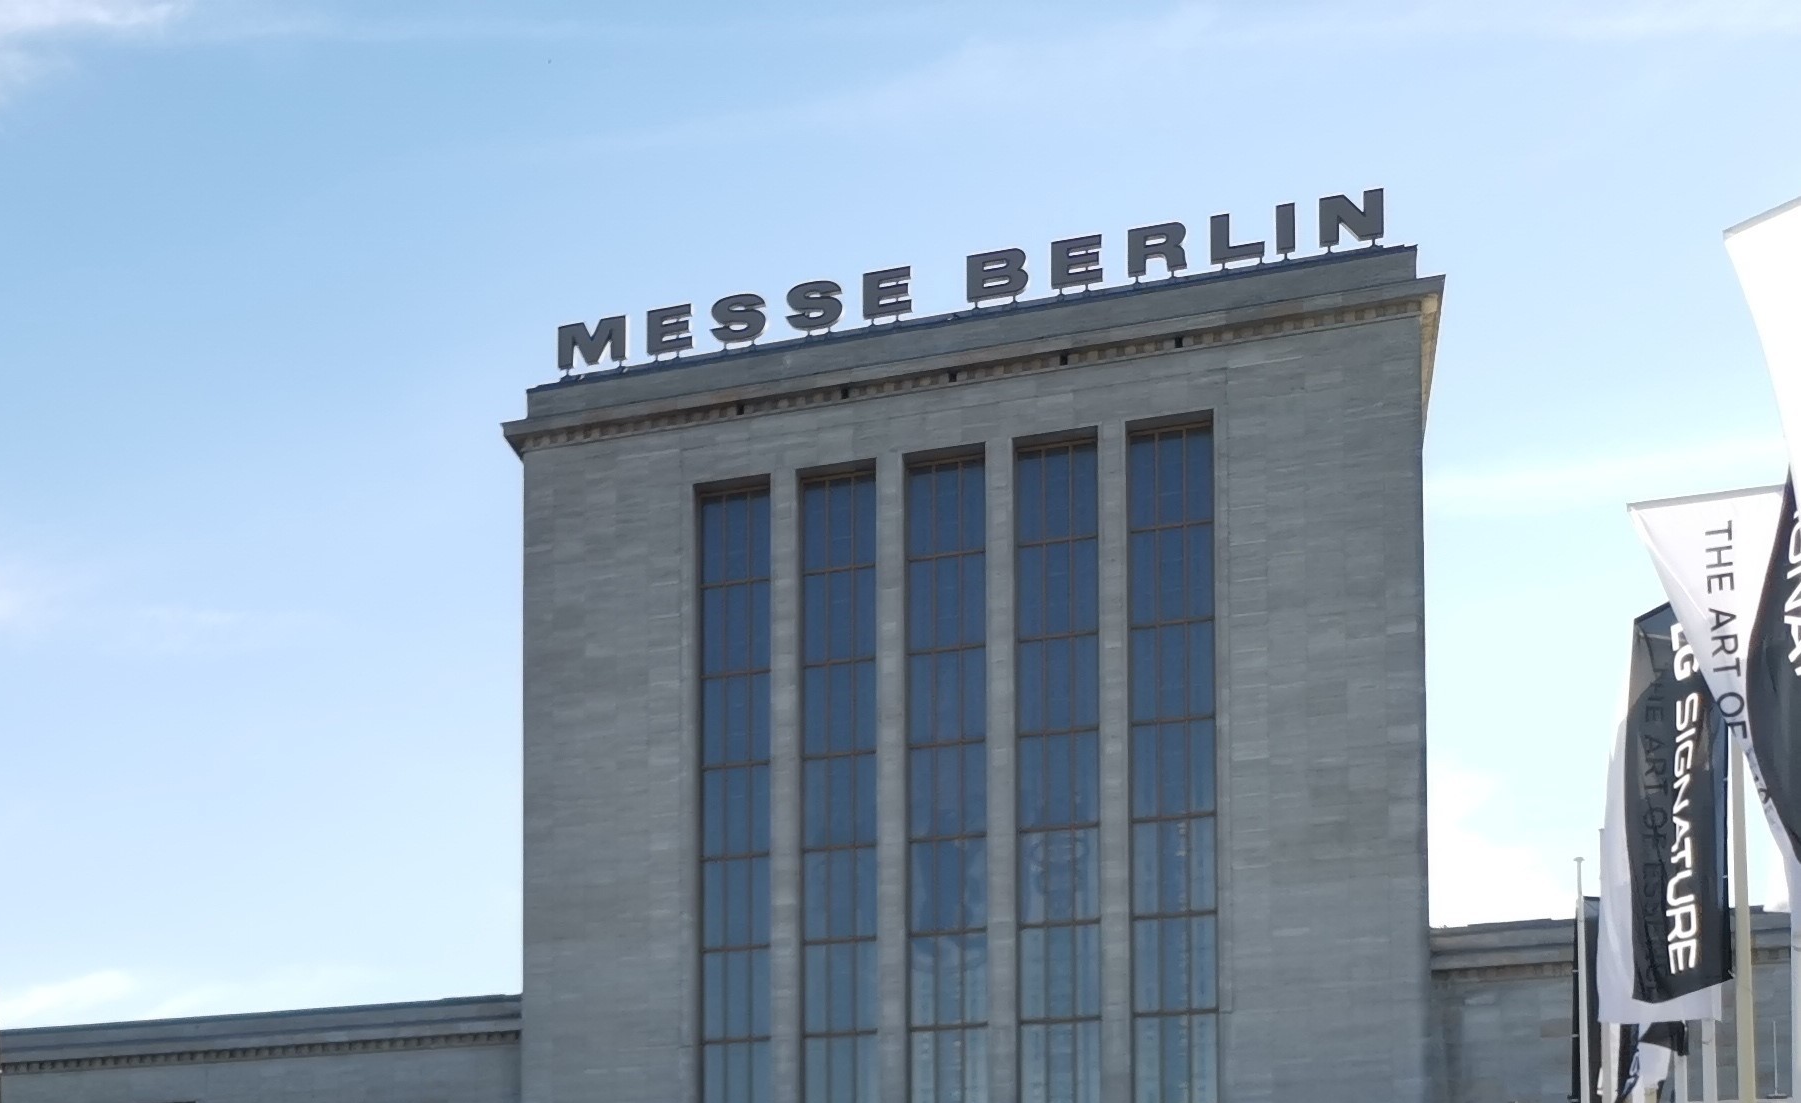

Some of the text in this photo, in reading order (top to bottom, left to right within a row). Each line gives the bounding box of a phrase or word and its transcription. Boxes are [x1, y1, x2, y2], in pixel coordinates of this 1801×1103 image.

[557, 187, 1385, 371] MESSE BERLIN
[1704, 519, 1748, 741] THE ART OF
[1665, 692, 1699, 976] SIGNATURE
